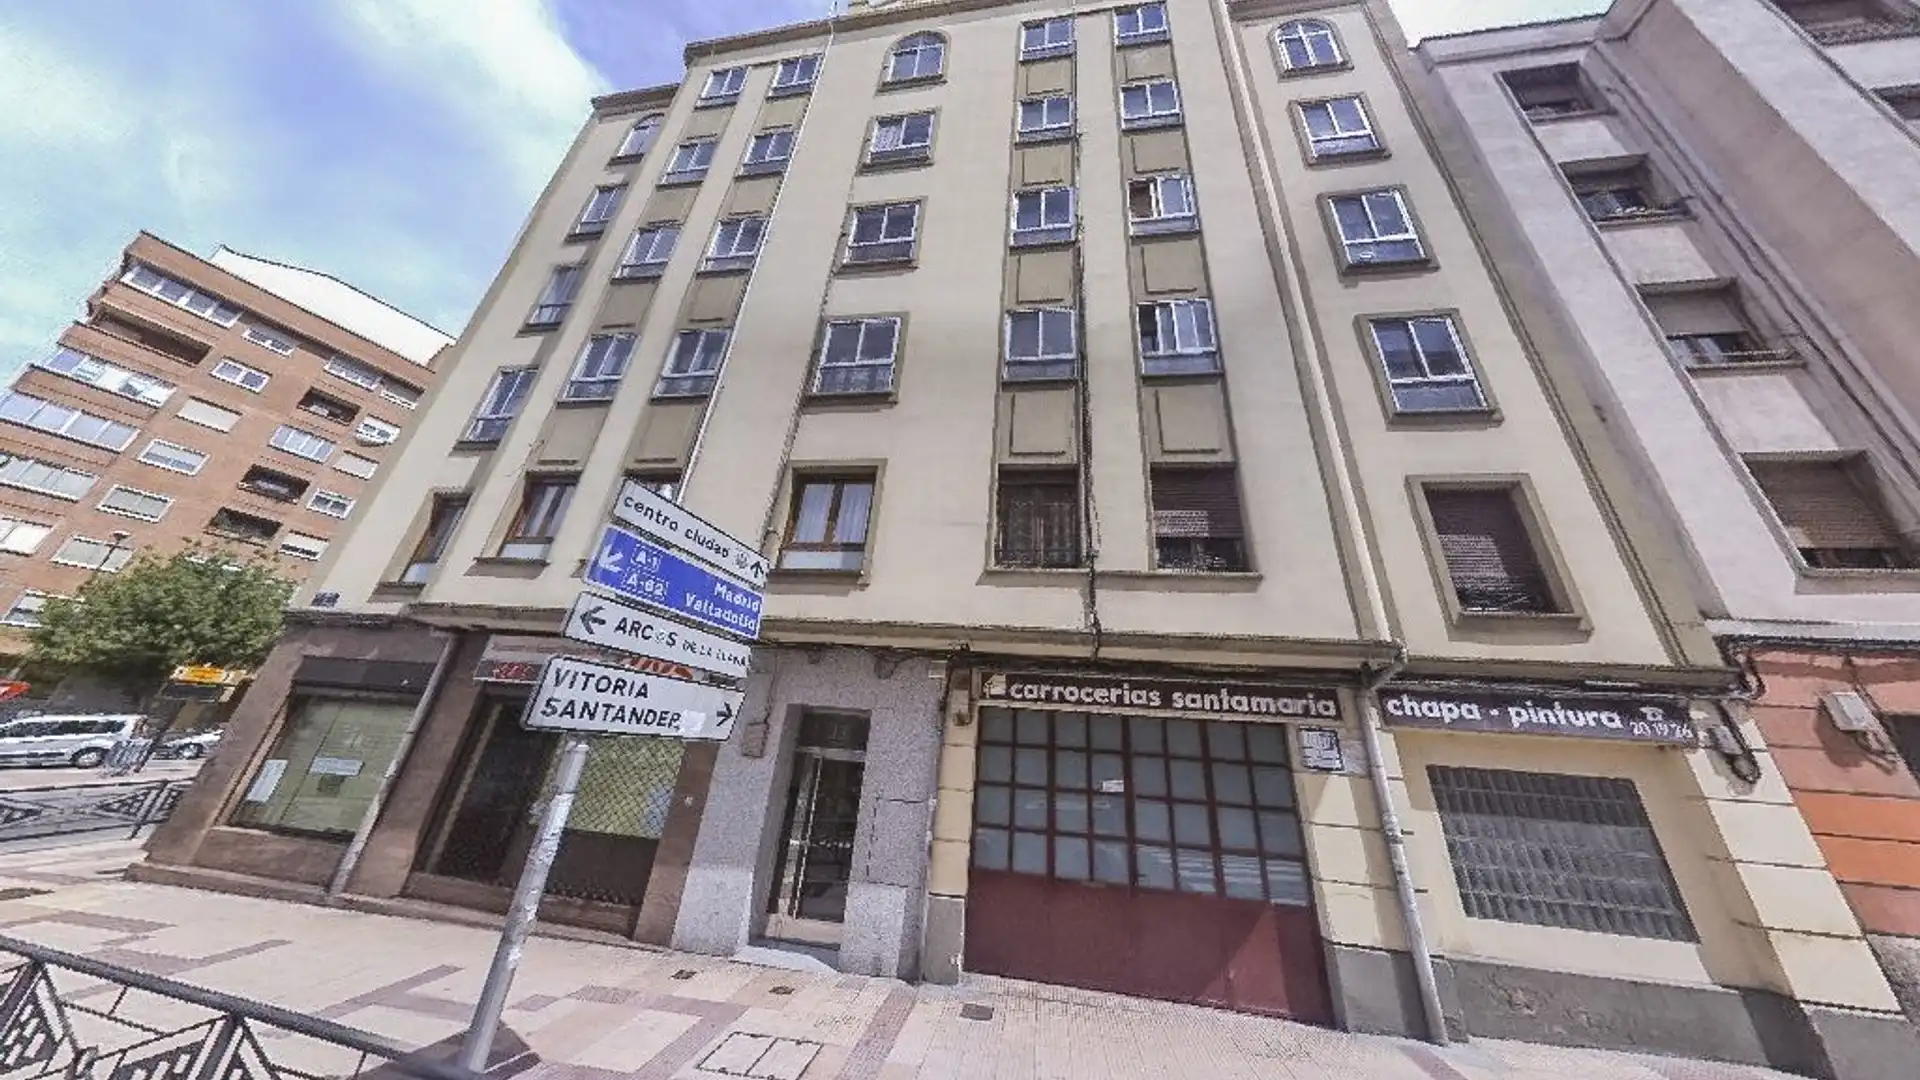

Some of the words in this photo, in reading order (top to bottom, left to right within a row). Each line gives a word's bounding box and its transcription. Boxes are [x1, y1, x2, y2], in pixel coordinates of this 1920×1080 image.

[623, 496, 679, 532] centro
[685, 592, 757, 631] Valladolid
[714, 583, 760, 612] Madrid
[553, 667, 649, 699] VITORIA
[1010, 682, 1162, 708] carrocerias
[1171, 688, 1337, 718] santamaria
[1386, 693, 1482, 724] chapa
[1508, 699, 1624, 729] pintura
